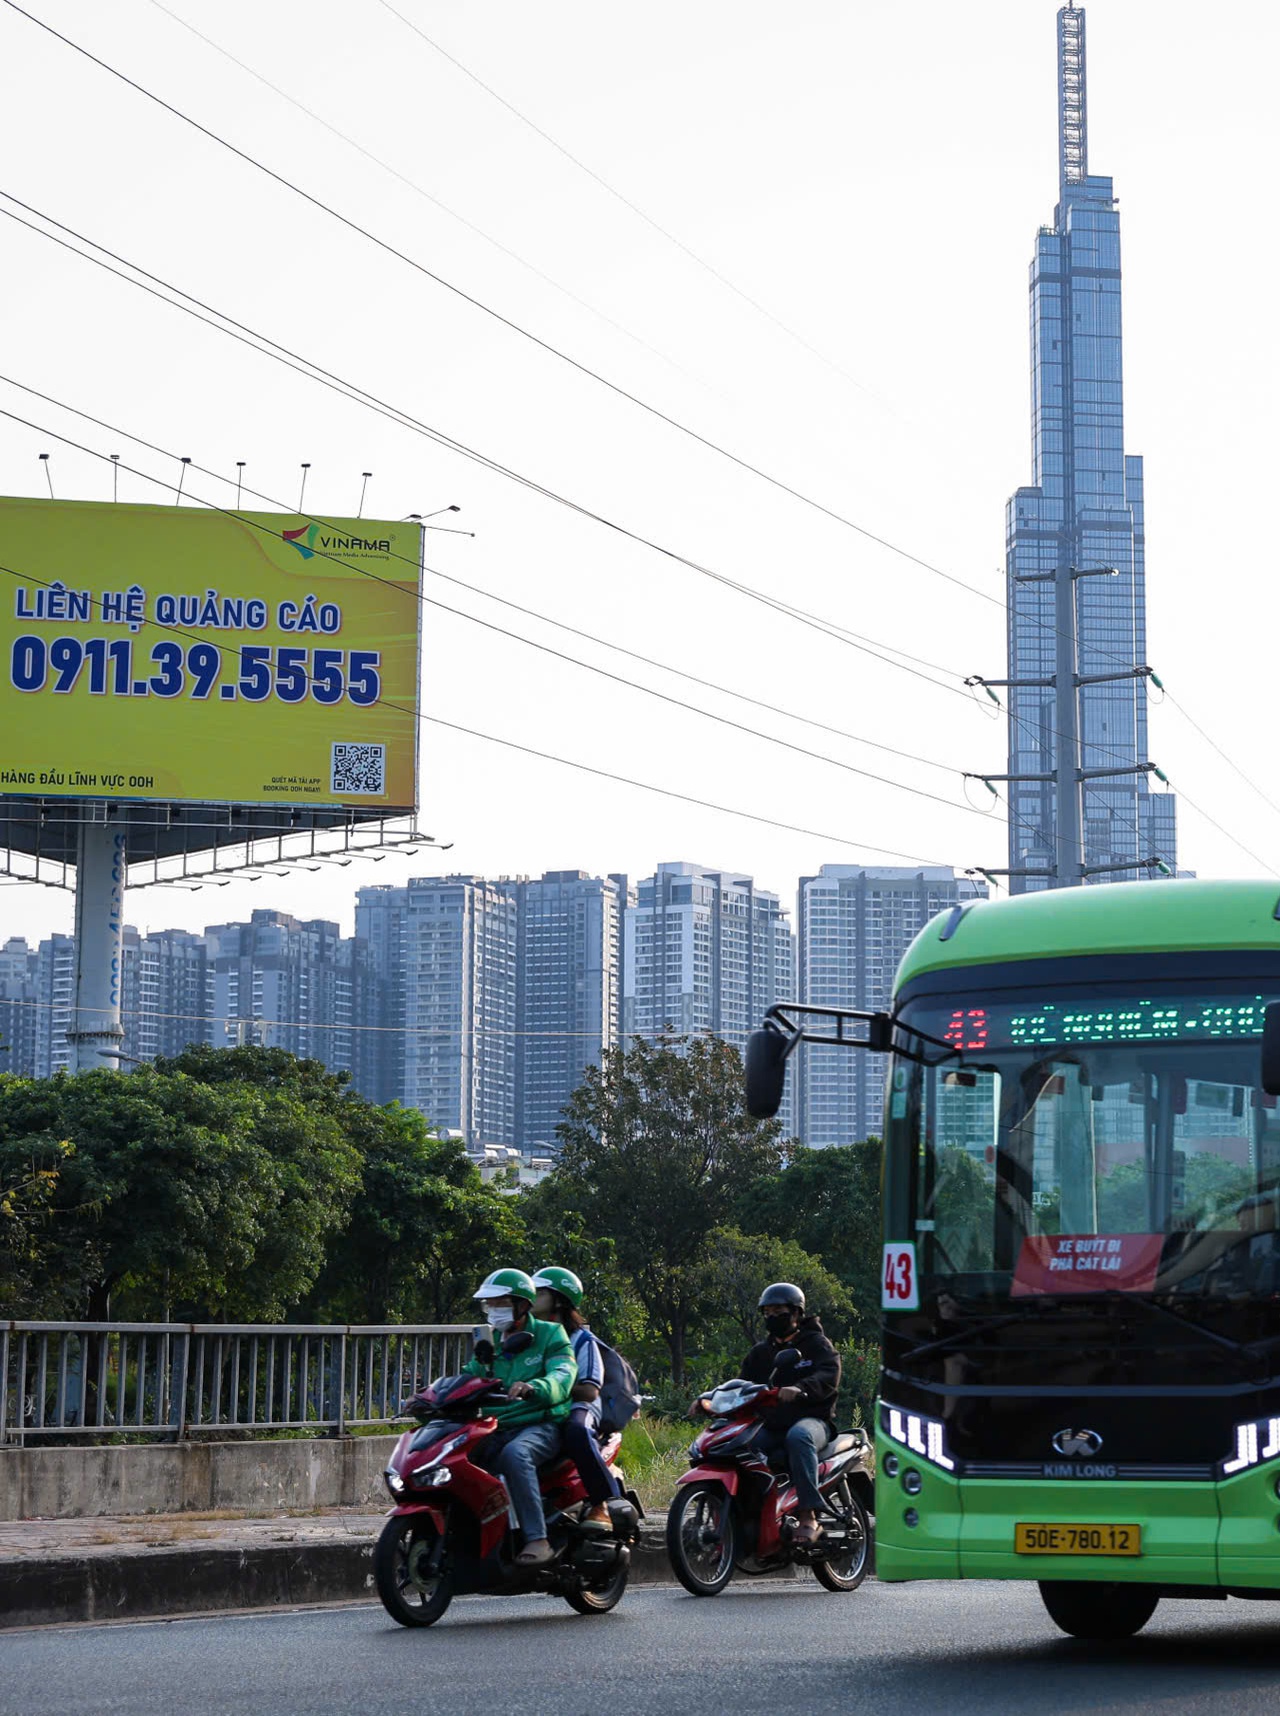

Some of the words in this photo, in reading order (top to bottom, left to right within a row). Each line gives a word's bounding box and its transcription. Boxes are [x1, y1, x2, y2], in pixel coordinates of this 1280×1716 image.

[320, 536, 390, 551] VINAMA
[16, 581, 91, 622] LIÊN
[101, 584, 145, 632] HỆ
[156, 589, 267, 630] QUẢNG
[277, 593, 341, 634] CÁO
[11, 634, 381, 706] 0911.39.5555
[1, 769, 36, 784] HÀNG
[40, 768, 65, 785] ĐẦU
[68, 771, 97, 786] LĨNH
[101, 774, 125, 790] VỰC
[129, 776, 154, 788] OOH
[1057, 1239, 1073, 1252] XE
[1075, 1236, 1104, 1252] BUÝT
[1076, 1254, 1099, 1271] CÁT
[885, 1252, 912, 1300] 43
[1044, 1464, 1073, 1477] KIM
[1075, 1465, 1117, 1477] LONG
[1024, 1529, 1130, 1550] 50E-780.12
